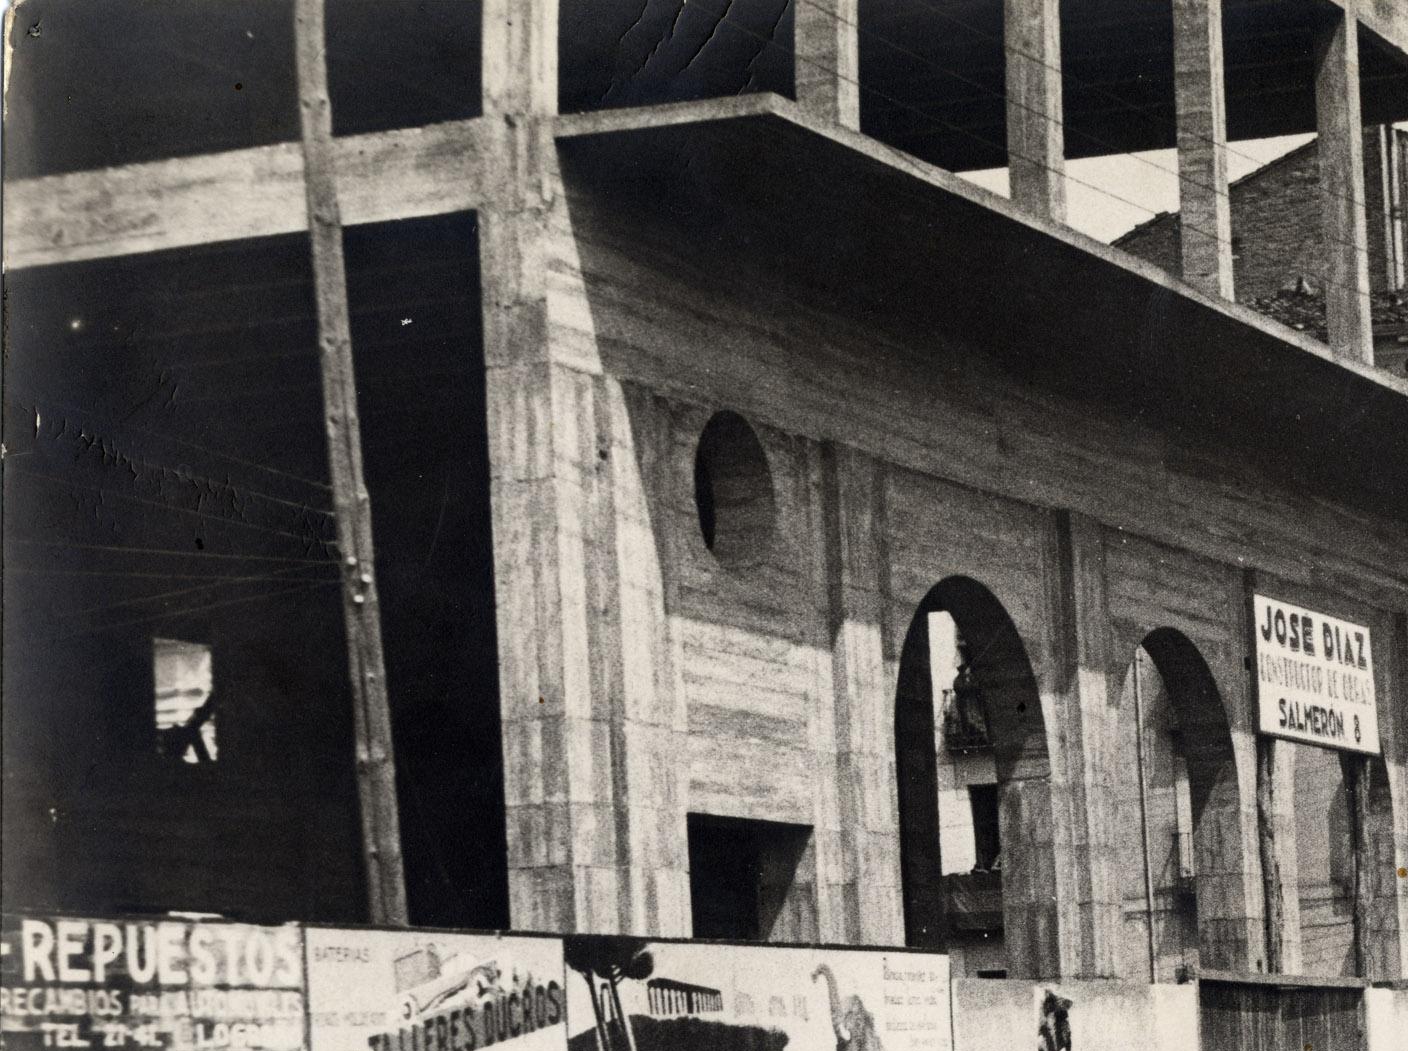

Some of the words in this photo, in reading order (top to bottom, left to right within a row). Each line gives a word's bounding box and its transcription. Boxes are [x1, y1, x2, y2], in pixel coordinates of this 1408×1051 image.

[22, 919, 302, 986] REPUESTOS
[0, 986, 122, 1016] RECAMBIOS
[483, 979, 561, 1047] DUCROS
